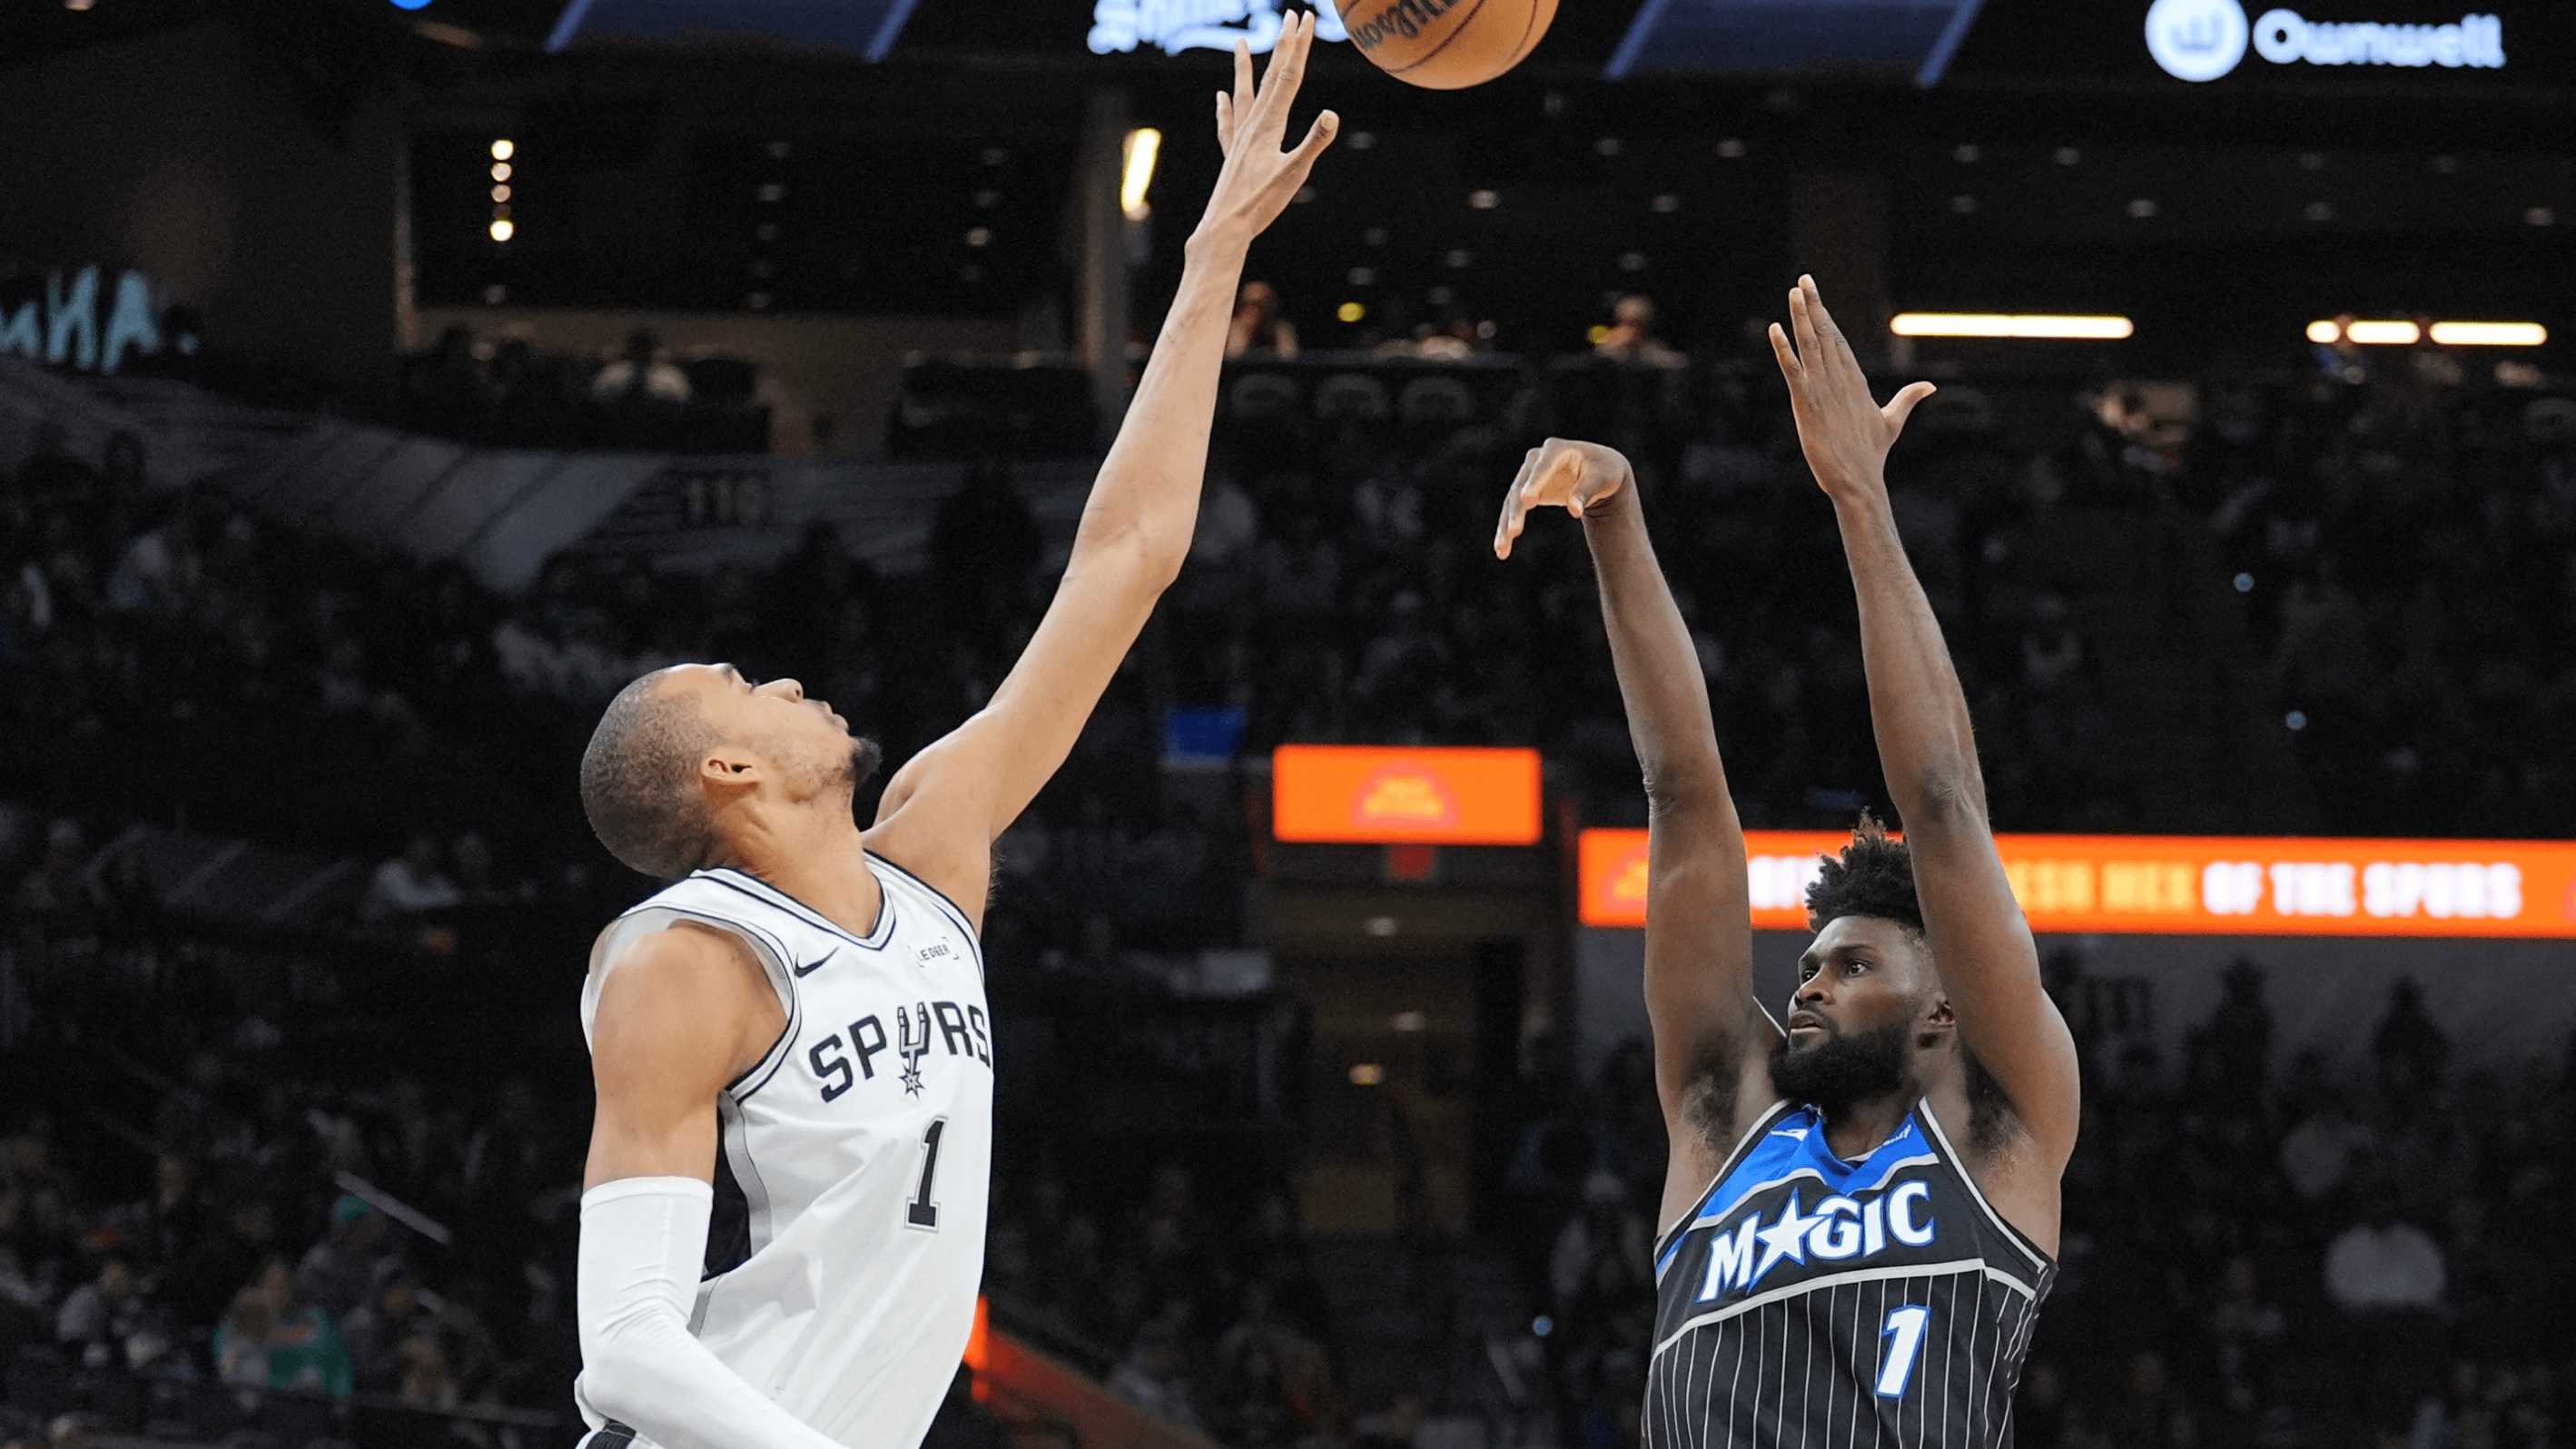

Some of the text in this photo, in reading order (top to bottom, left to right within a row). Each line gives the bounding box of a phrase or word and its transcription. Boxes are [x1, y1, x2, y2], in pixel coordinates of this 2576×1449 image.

[809, 1001, 992, 1102] SPURS
[904, 1116, 948, 1233] 1
[1874, 1304, 1930, 1399] 1
